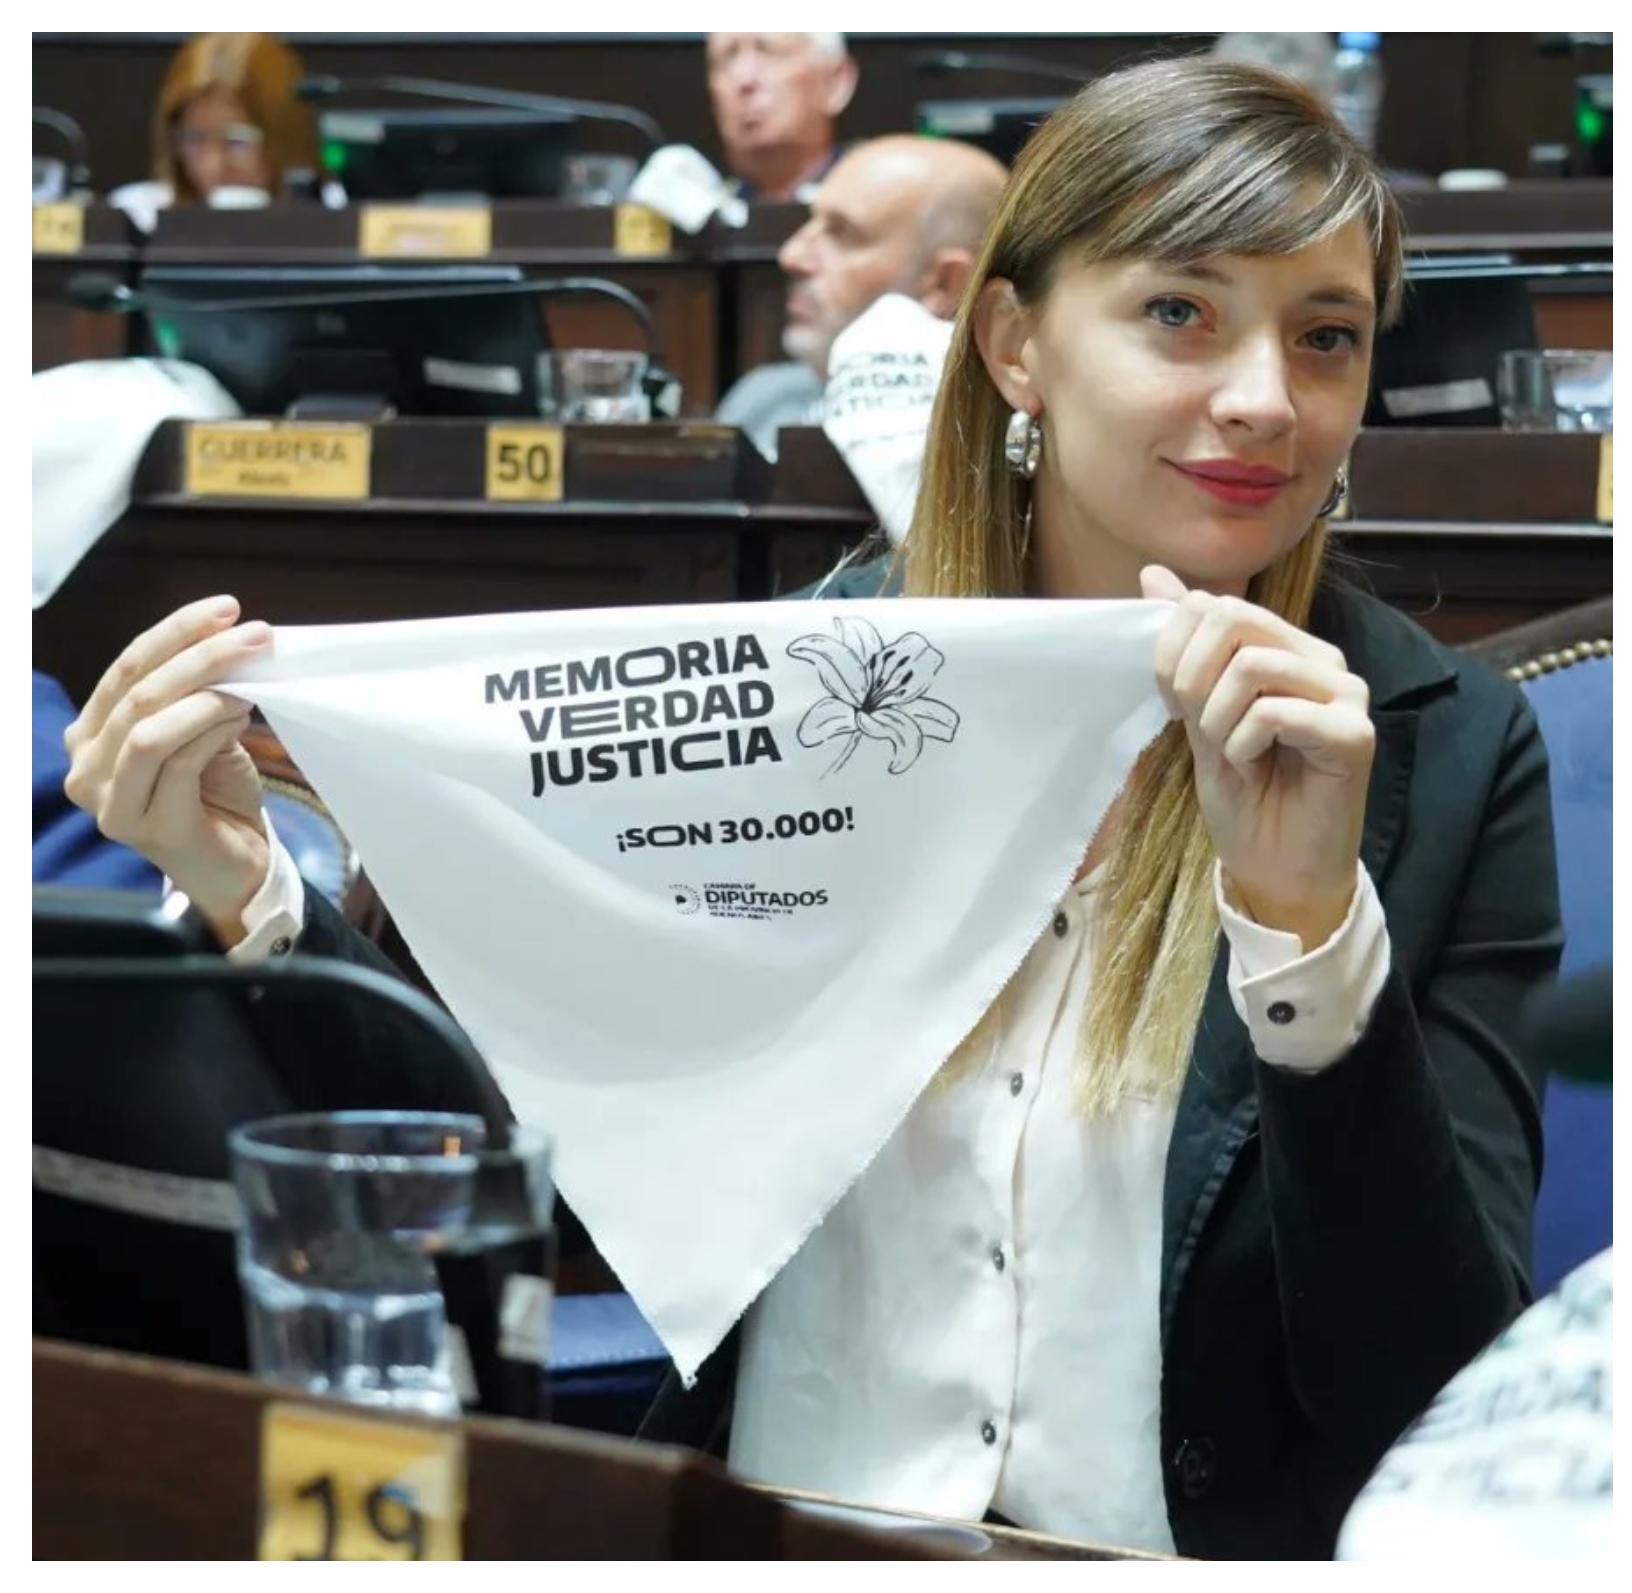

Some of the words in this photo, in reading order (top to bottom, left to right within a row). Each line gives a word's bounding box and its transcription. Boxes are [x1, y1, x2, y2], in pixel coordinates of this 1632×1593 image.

[498, 445, 551, 482] 50
[485, 634, 769, 703] MEMORIA
[520, 681, 773, 742] VERDAD
[531, 727, 782, 797] JUSTICIA
[616, 823, 712, 852] ¡SON
[721, 807, 854, 842] 30.000!
[704, 889, 829, 907] DIPUTADOS
[292, 1471, 424, 1560] 19
